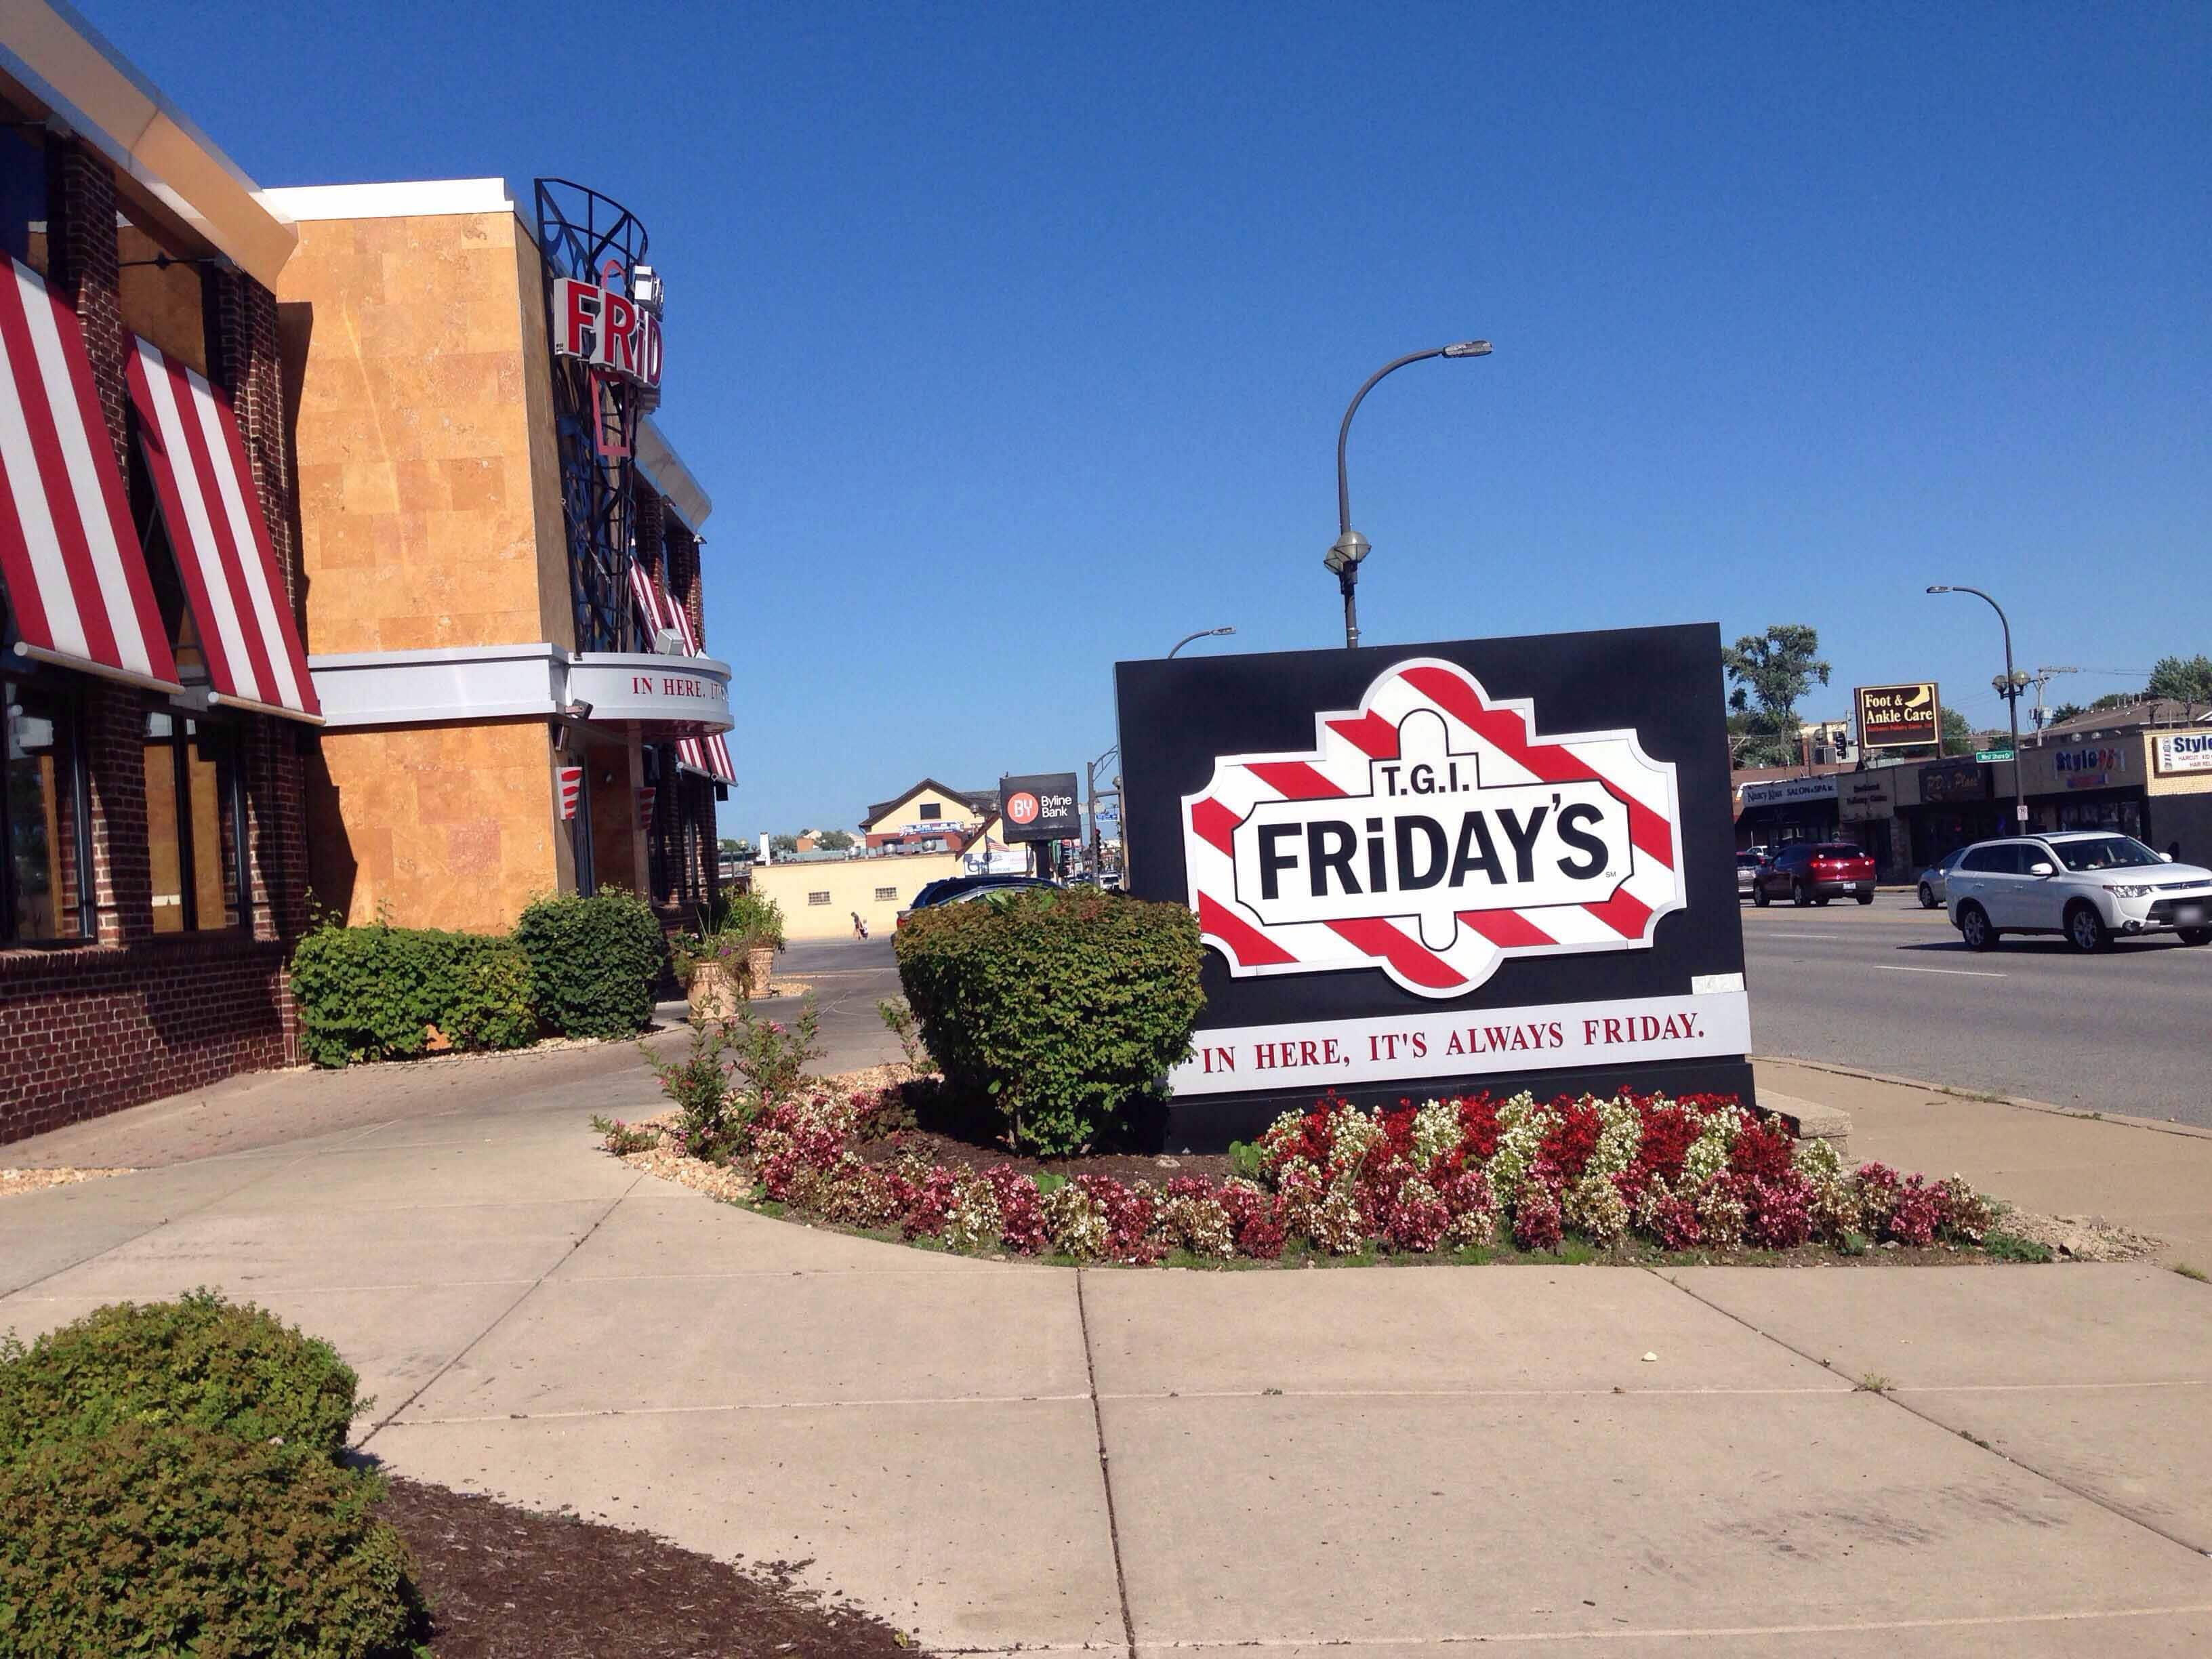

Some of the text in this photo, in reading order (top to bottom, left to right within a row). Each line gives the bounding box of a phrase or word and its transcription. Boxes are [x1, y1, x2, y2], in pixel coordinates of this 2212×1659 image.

[632, 678, 653, 694] IN
[1865, 694, 1903, 708] Foot &
[1866, 708, 1933, 724] Ankle Care
[1381, 763, 1469, 796] T.G.I.
[1014, 799, 1033, 817] BY
[1041, 795, 1072, 808] Byline
[1042, 806, 1068, 818] Bank
[1202, 1012, 1704, 1074] IN HERE, IT'S ALWAYS FRIDAY.
